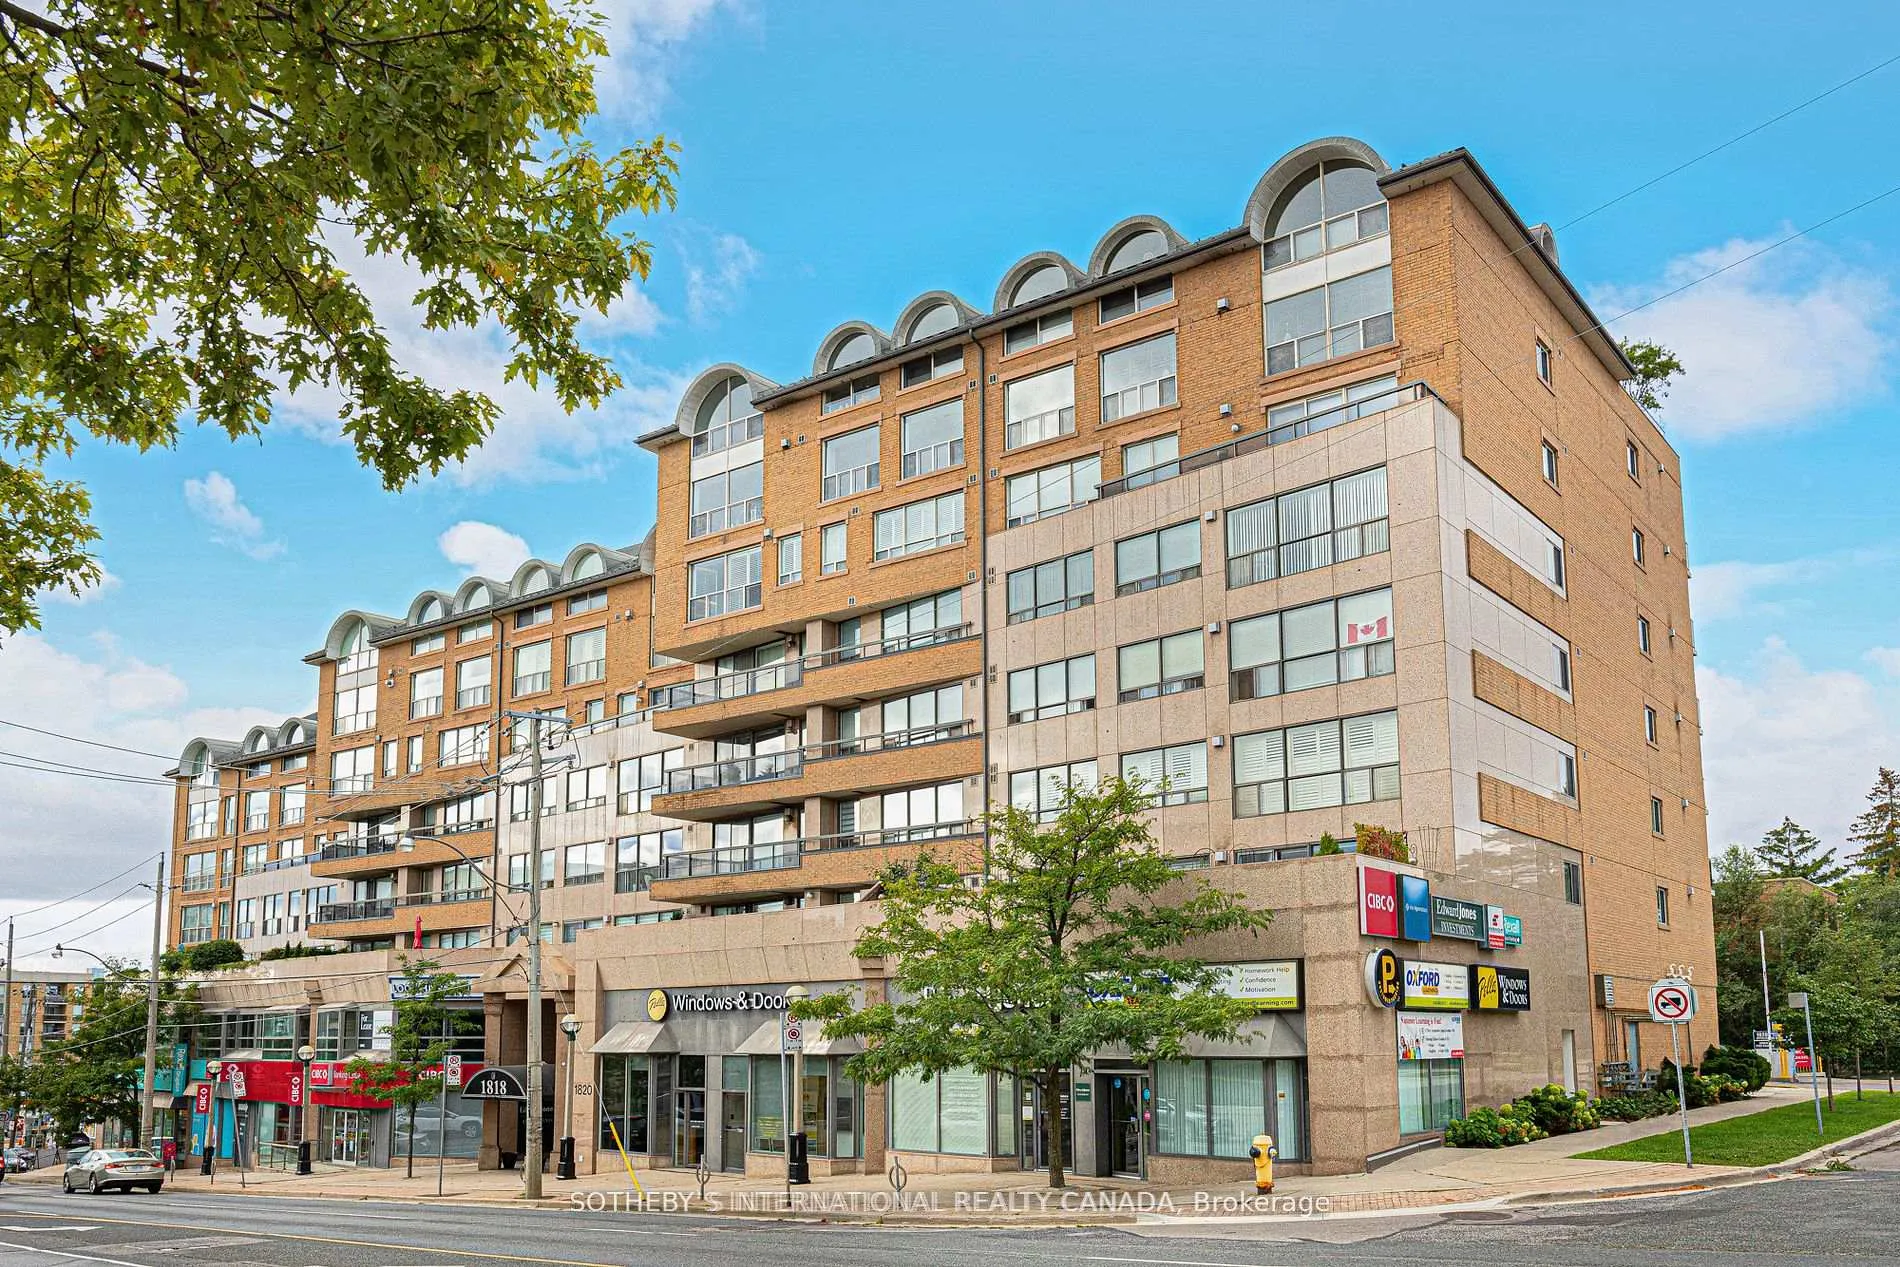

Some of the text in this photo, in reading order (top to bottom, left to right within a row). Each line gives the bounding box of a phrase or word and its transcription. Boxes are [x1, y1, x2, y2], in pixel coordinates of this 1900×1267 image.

[1367, 893, 1387, 911] CIBC
[1440, 921, 1475, 936] INVESTMENTS
[1245, 976, 1277, 984] Confidence
[1406, 968, 1440, 987] OXFORD
[1478, 974, 1497, 1001] Pella
[672, 990, 788, 1011] Windows & Door
[291, 1084, 300, 1103] CIBC
[480, 1080, 507, 1095] 1818
[574, 1084, 593, 1096] 1820
[199, 1094, 208, 1111] CIBC
